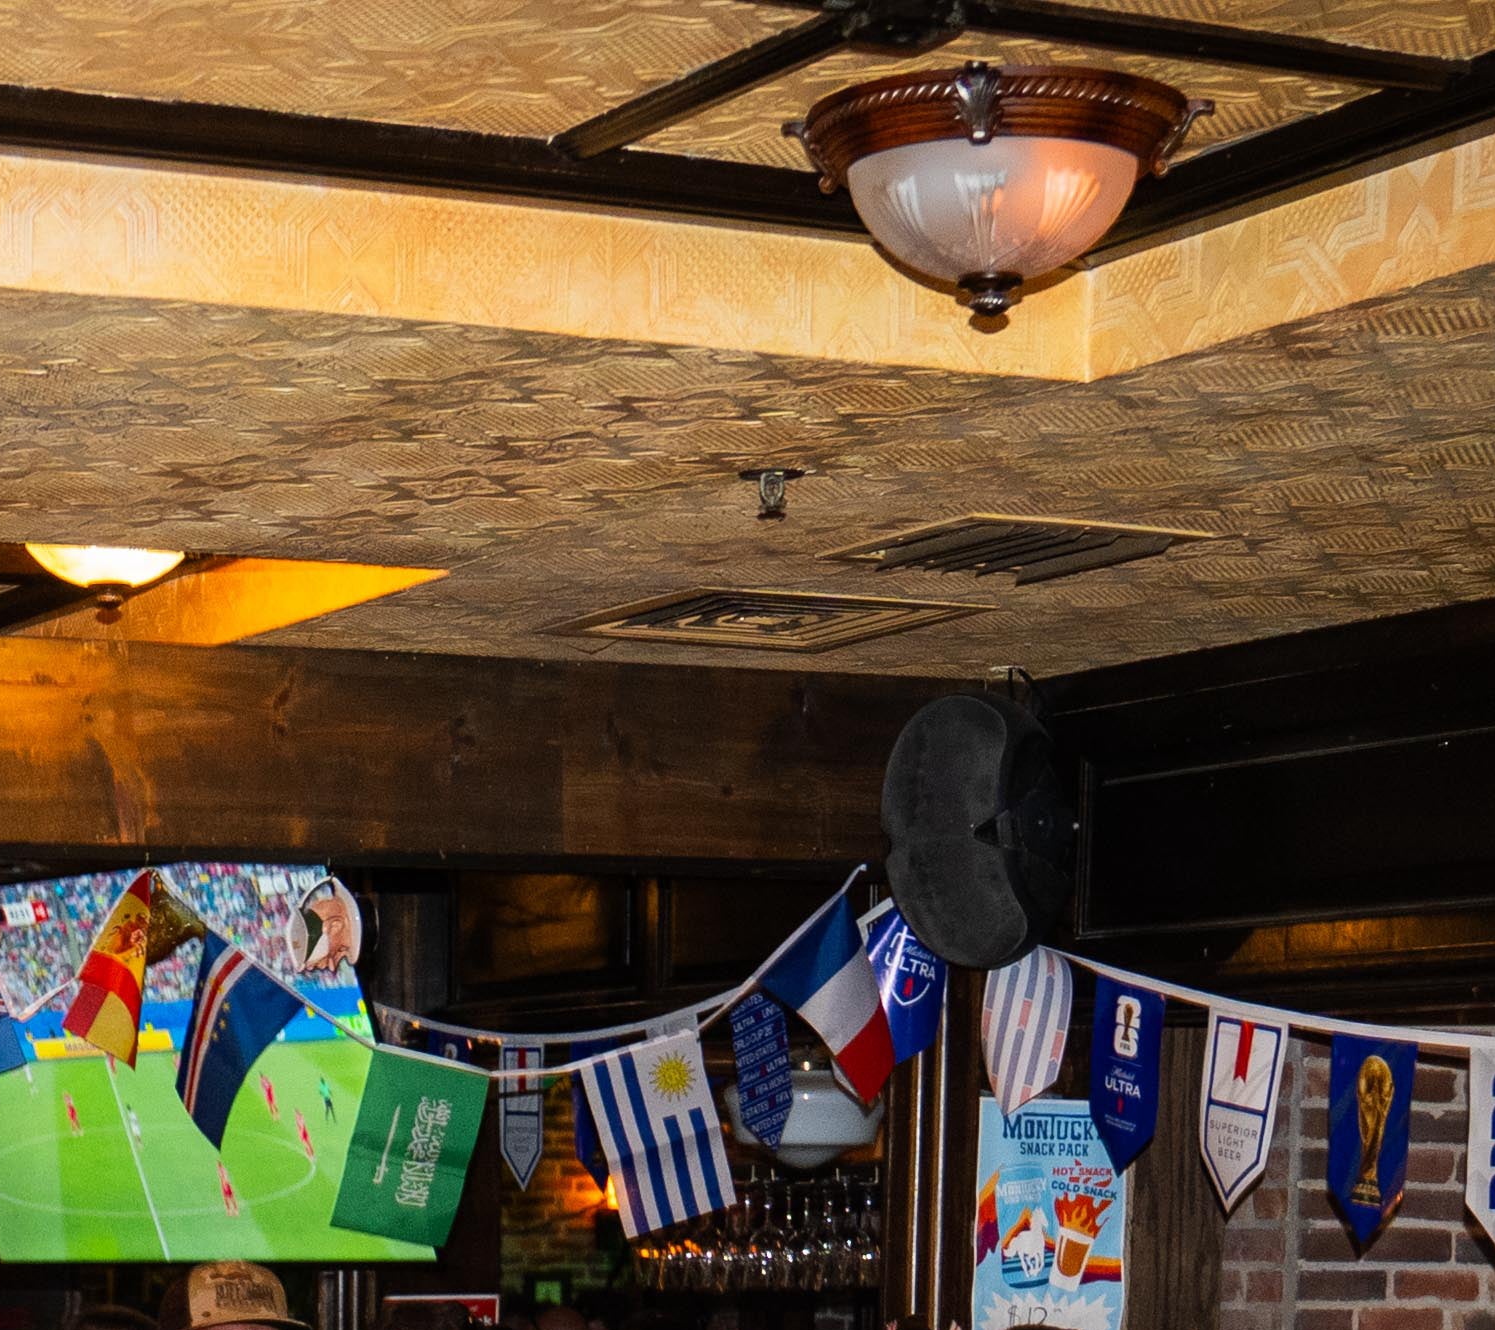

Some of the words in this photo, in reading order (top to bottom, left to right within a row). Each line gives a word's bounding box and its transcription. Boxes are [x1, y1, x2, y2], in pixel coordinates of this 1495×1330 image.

[1104, 1075, 1141, 1099] ULTRA
[1002, 1112, 1100, 1141] MONTUCK
[1209, 1119, 1258, 1140] SUPERIOR
[1019, 1141, 1055, 1157] SNACK
[1058, 1142, 1089, 1157] PACK
[1217, 1135, 1244, 1148] LIGHT
[1217, 1147, 1241, 1161] BEER
[1052, 1166, 1074, 1176] HOT
[1078, 1166, 1113, 1177] SNACK
[1051, 1180, 1080, 1193] COLD
[1083, 1186, 1117, 1200] SNACK
